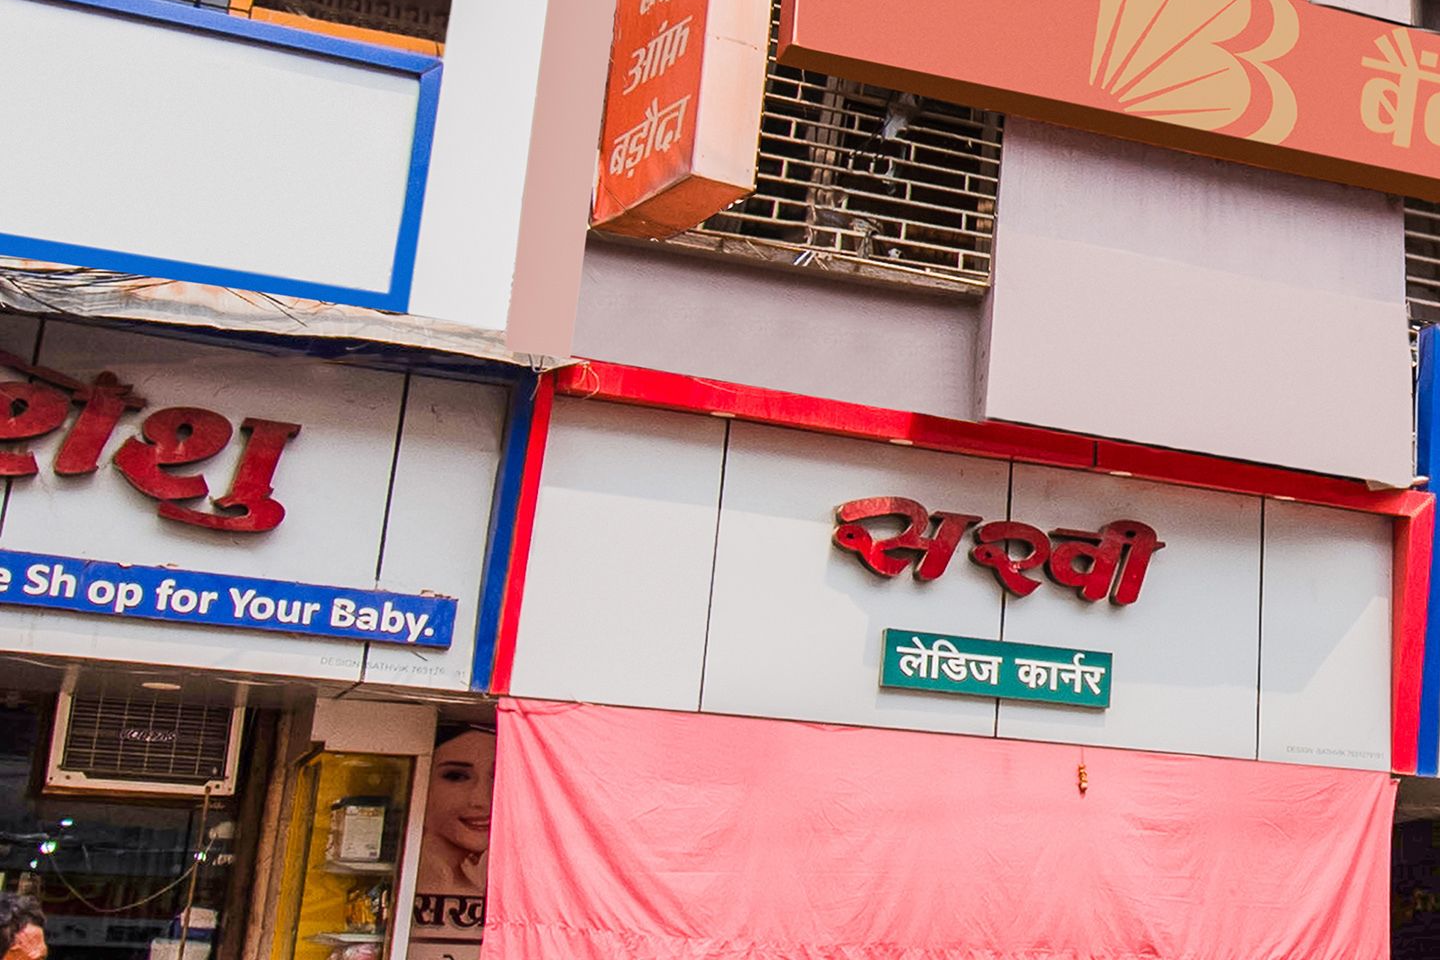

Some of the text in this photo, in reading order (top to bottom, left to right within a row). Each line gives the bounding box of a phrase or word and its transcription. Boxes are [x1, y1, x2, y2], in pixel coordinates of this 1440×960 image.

[155, 579, 219, 615] for
[229, 587, 320, 625] Your
[330, 597, 435, 642] Baby.
[896, 637, 1106, 695] लेडिज कार्नर
